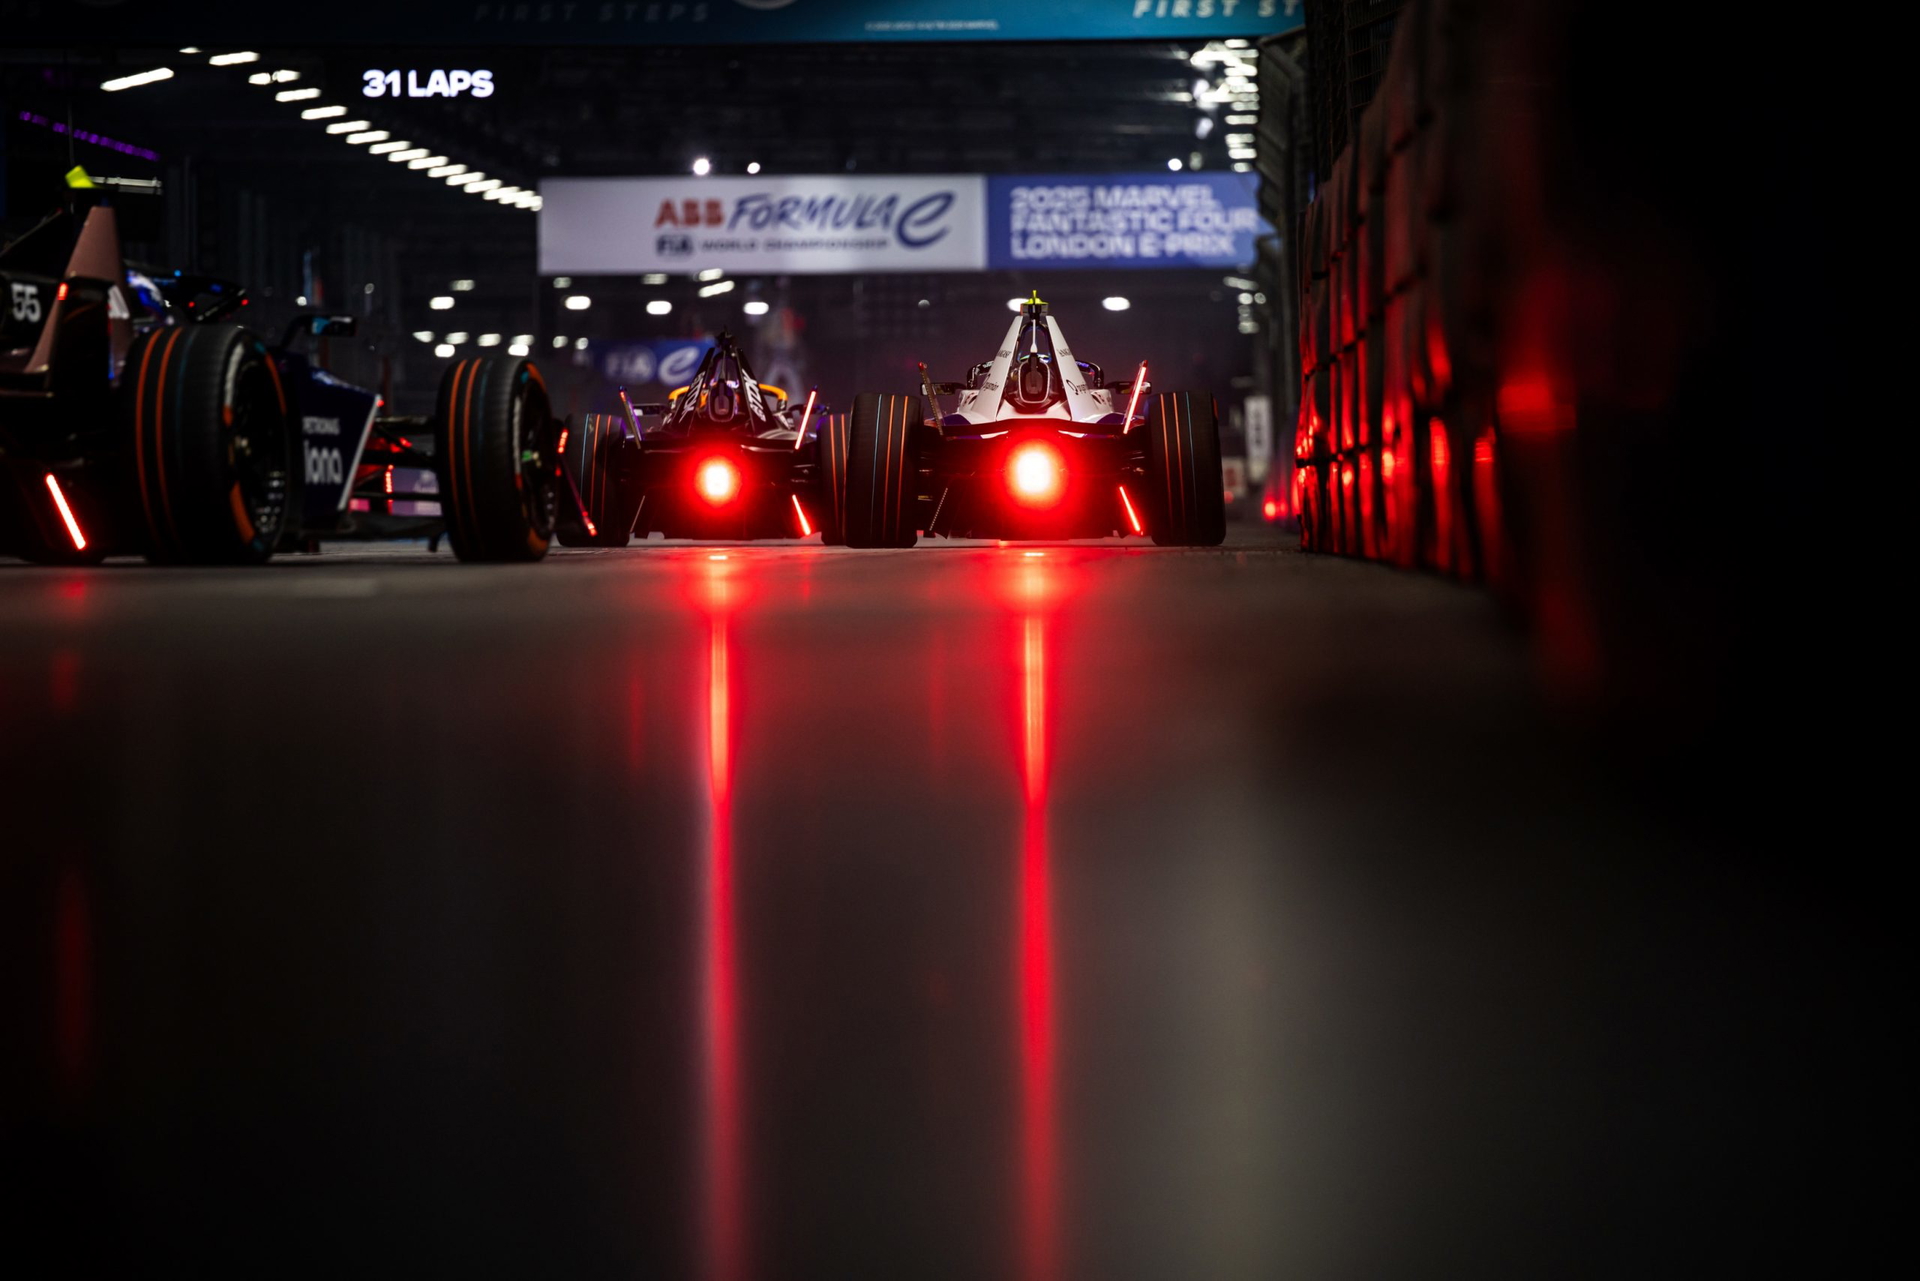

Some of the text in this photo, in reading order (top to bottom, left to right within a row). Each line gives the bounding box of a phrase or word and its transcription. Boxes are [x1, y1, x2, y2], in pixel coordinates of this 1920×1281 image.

[598, 3, 709, 23] STEPS
[1132, 0, 1240, 19] FIRST
[362, 69, 495, 98] 31 LAPS
[1093, 185, 1221, 209] MARVEL
[654, 198, 725, 229] ABB
[727, 192, 901, 231] FORMULA
[1011, 207, 1258, 234] FANTASTIC FOUR
[655, 234, 890, 257] FIA WORLD CHAMPIONSHIP
[1011, 233, 1135, 259] LONDON
[10, 281, 42, 324] 55
